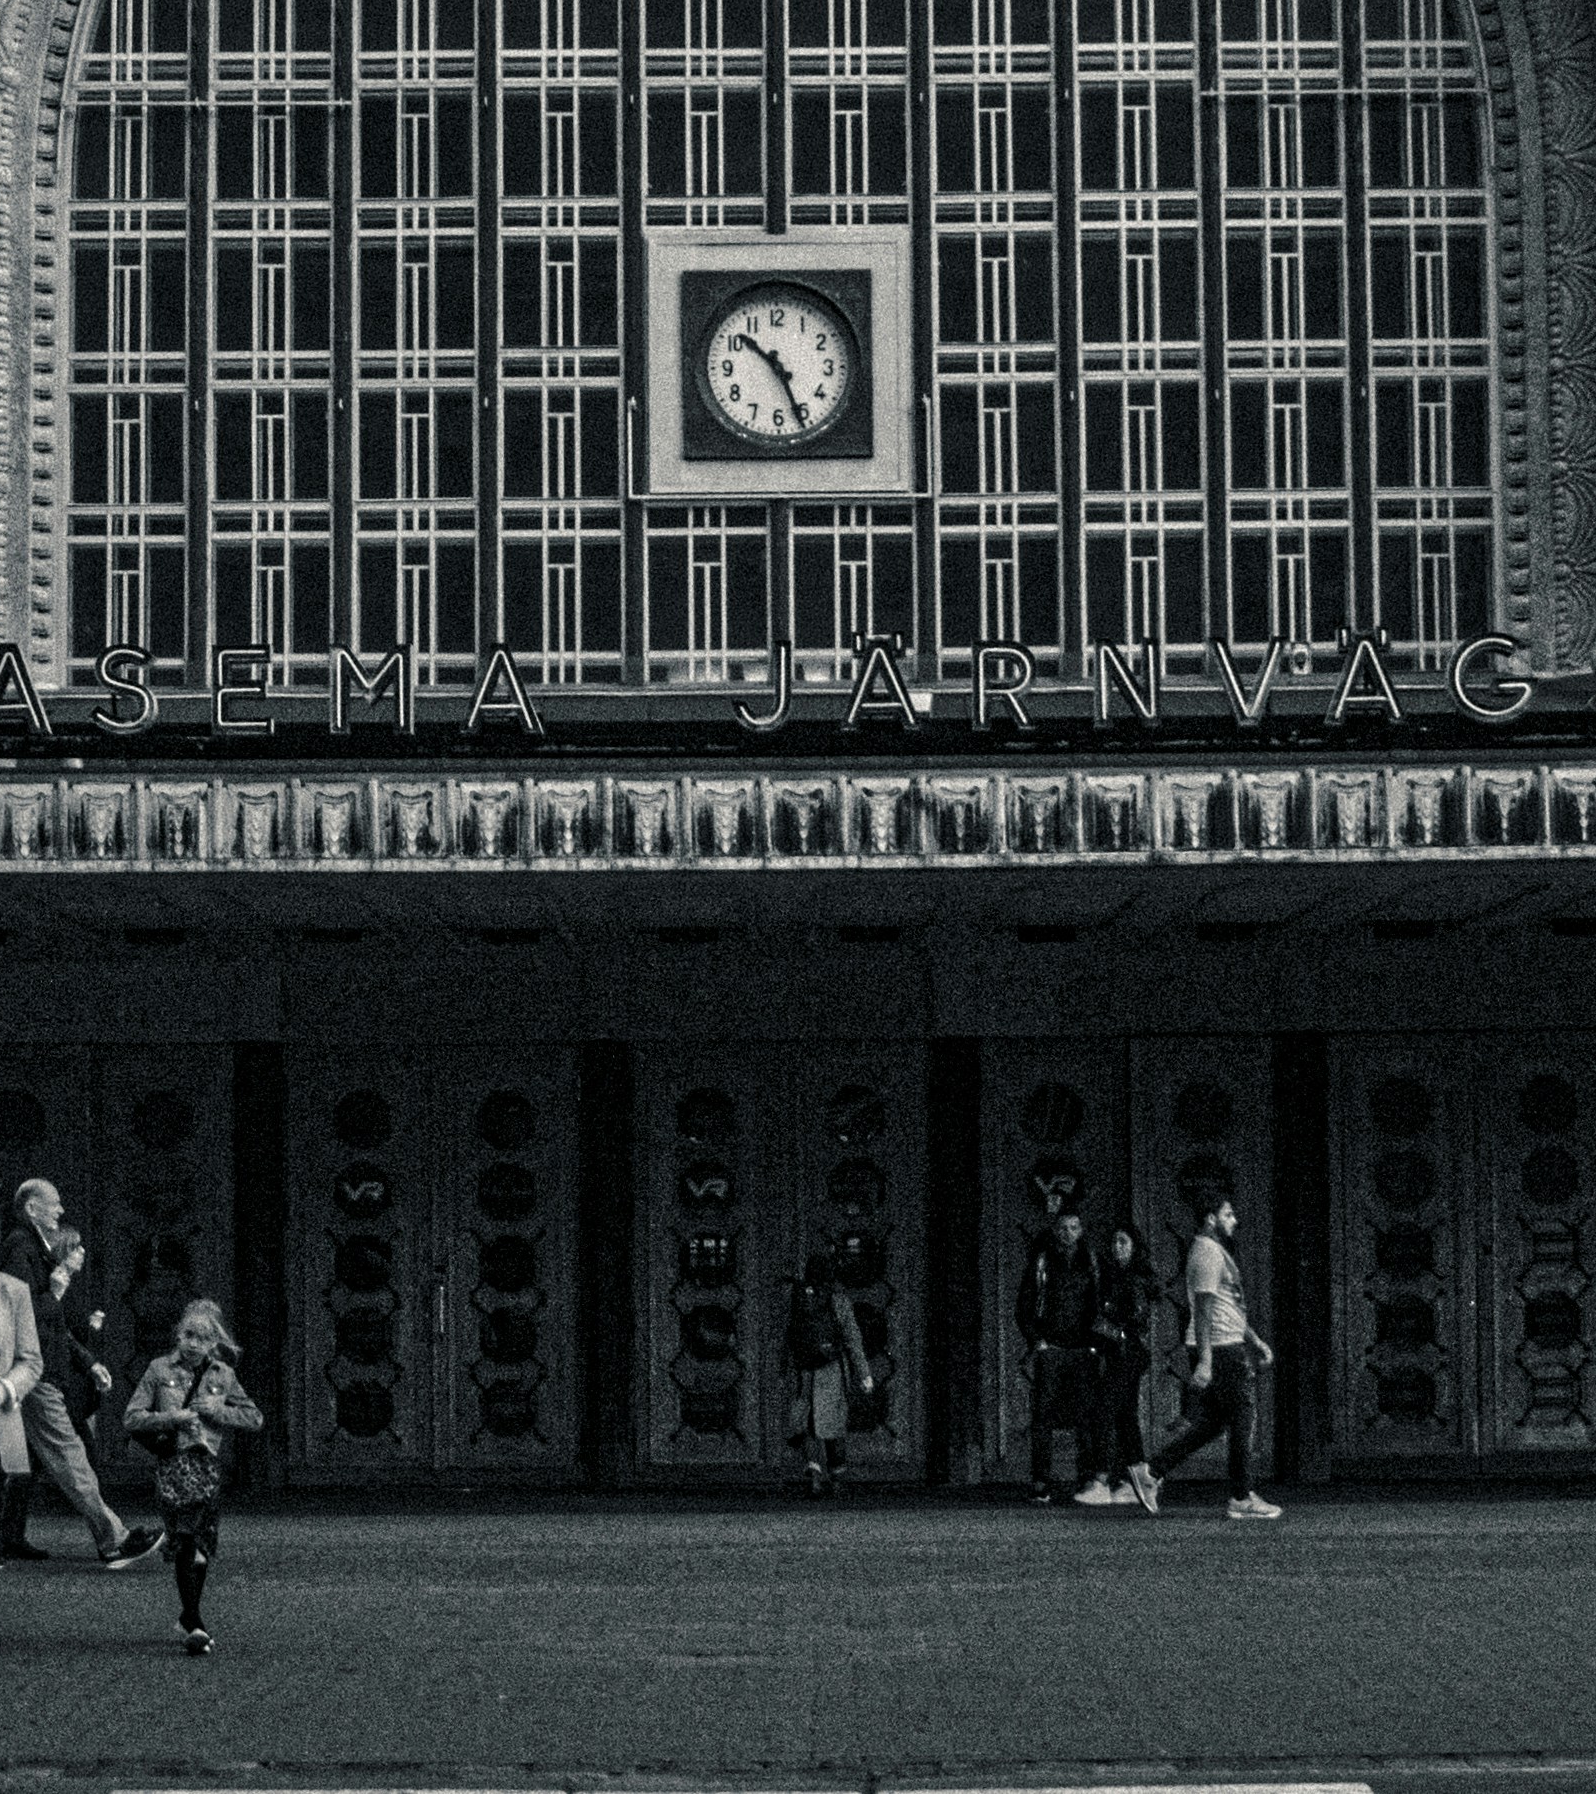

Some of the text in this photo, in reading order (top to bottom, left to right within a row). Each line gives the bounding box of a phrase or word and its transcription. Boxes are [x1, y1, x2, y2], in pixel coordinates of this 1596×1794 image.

[746, 316, 758, 334] 11
[769, 308, 785, 327] 12
[727, 334, 743, 352] 10
[815, 333, 827, 351] 2
[721, 359, 734, 377] 9
[823, 358, 835, 376] 3
[729, 383, 741, 402] 8
[813, 383, 826, 400] 4
[747, 403, 759, 421] 7
[772, 409, 785, 427] 6
